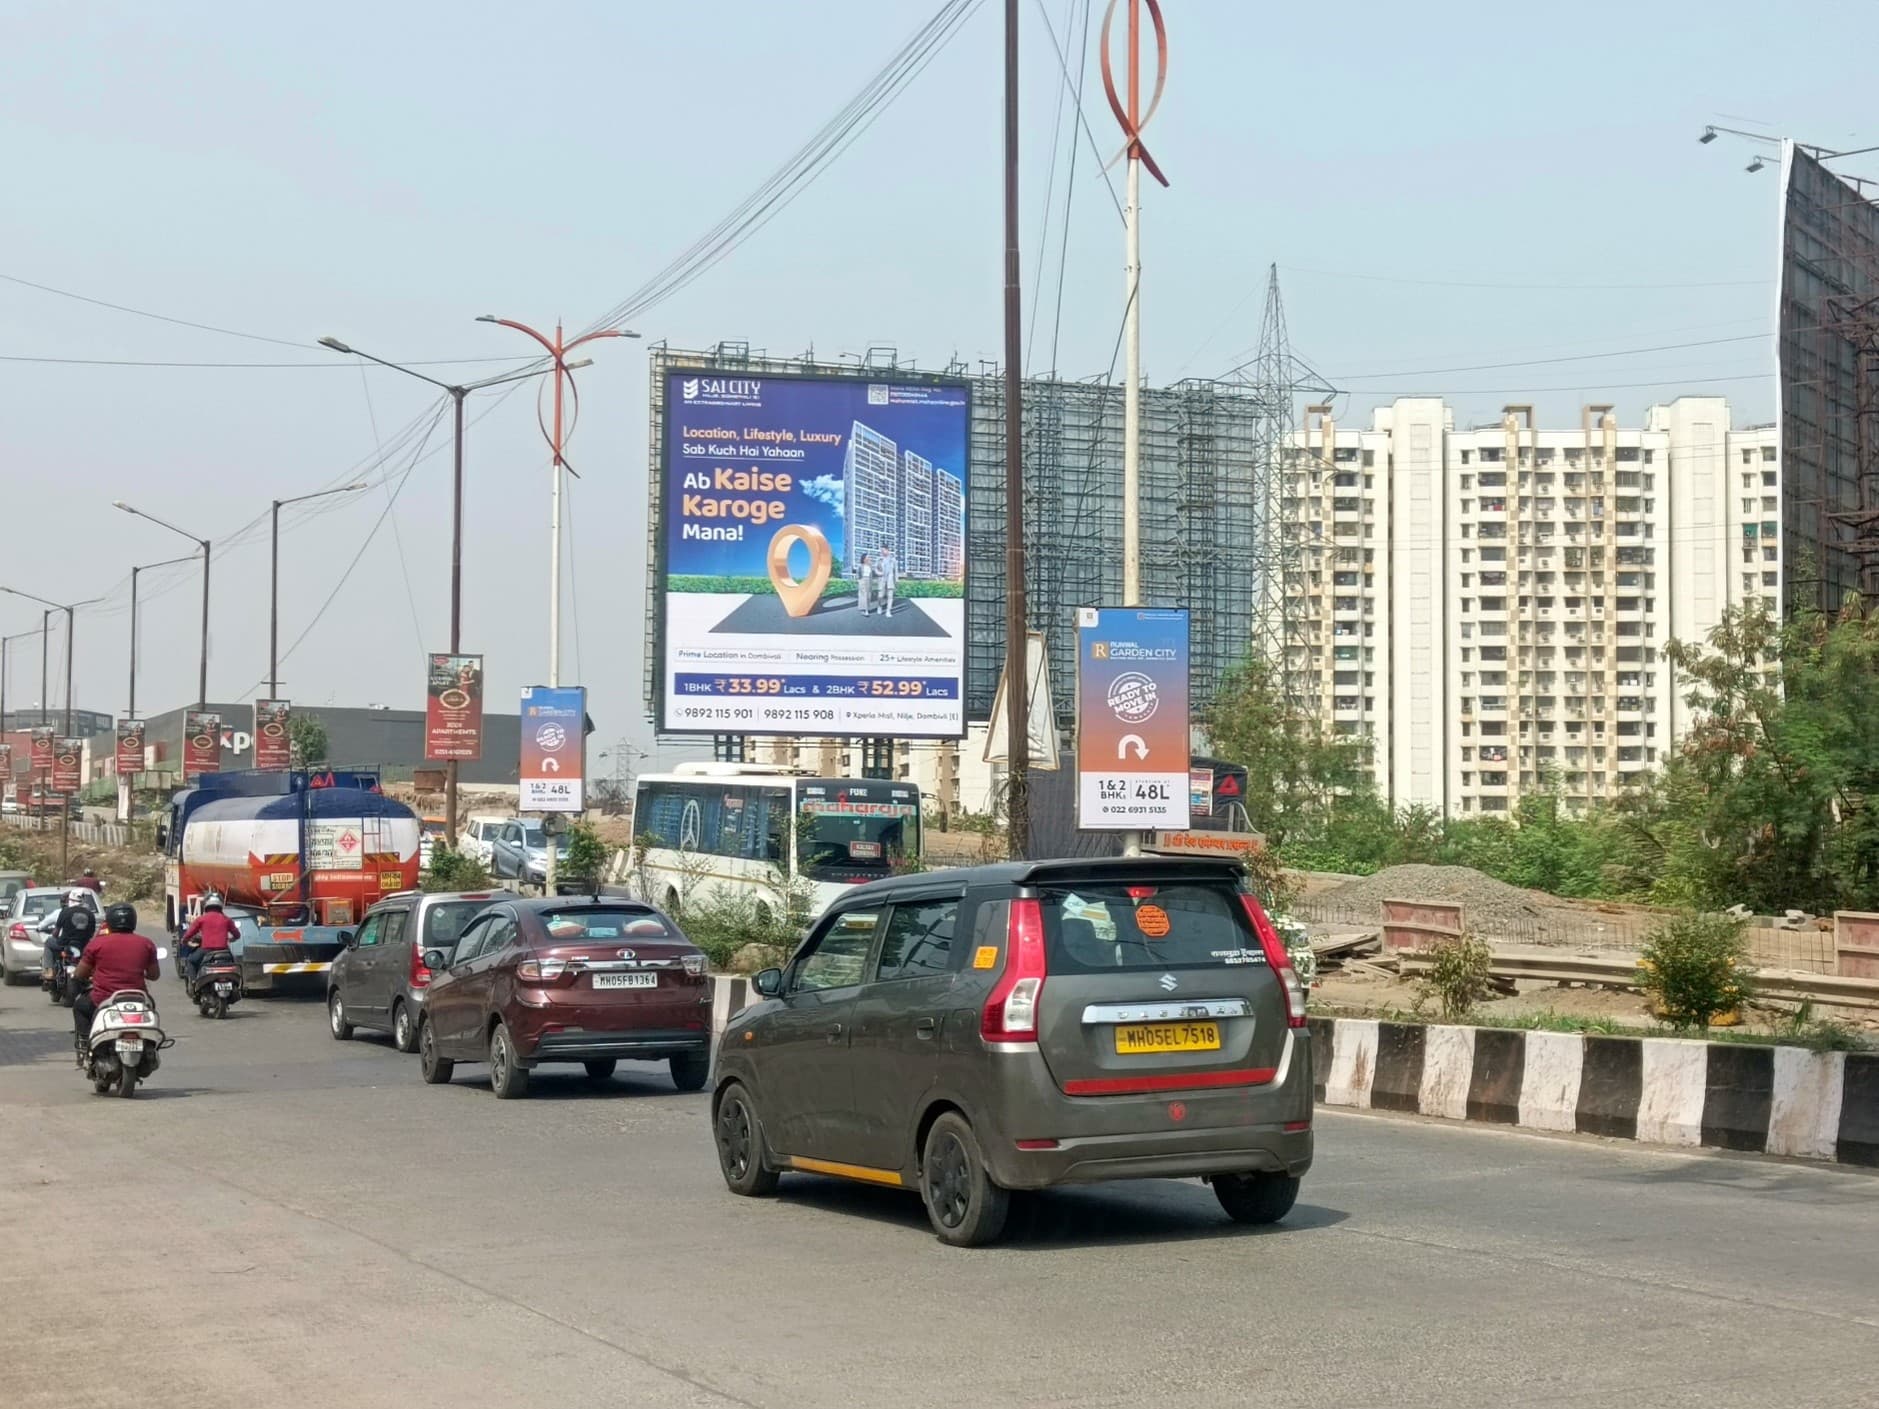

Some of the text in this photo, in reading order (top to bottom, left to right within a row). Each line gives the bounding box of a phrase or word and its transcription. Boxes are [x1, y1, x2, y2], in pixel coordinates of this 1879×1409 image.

[701, 379, 761, 394] SAI CITY
[683, 426, 842, 446] Location, Lifestyle, Luxury
[683, 443, 805, 458] Sab Kuch Hai Yahaan
[683, 466, 793, 493] Ab Kaise
[683, 493, 786, 525] Karoge
[682, 523, 745, 541] Mana!
[1110, 648, 1177, 657] GARDEN CITY
[683, 682, 712, 692] 1BHK
[784, 685, 806, 694] Lacs
[812, 685, 821, 694] &
[826, 685, 855, 695] 2BHK
[926, 687, 949, 696] Lacs
[1107, 687, 1142, 708] READY
[1141, 682, 1157, 693] TO
[1114, 696, 1146, 714] MOVE
[684, 707, 753, 719] 9892 115 901
[764, 709, 791, 720] 9892
[794, 710, 810, 720] 115
[1099, 780, 1126, 791] 1 & 2
